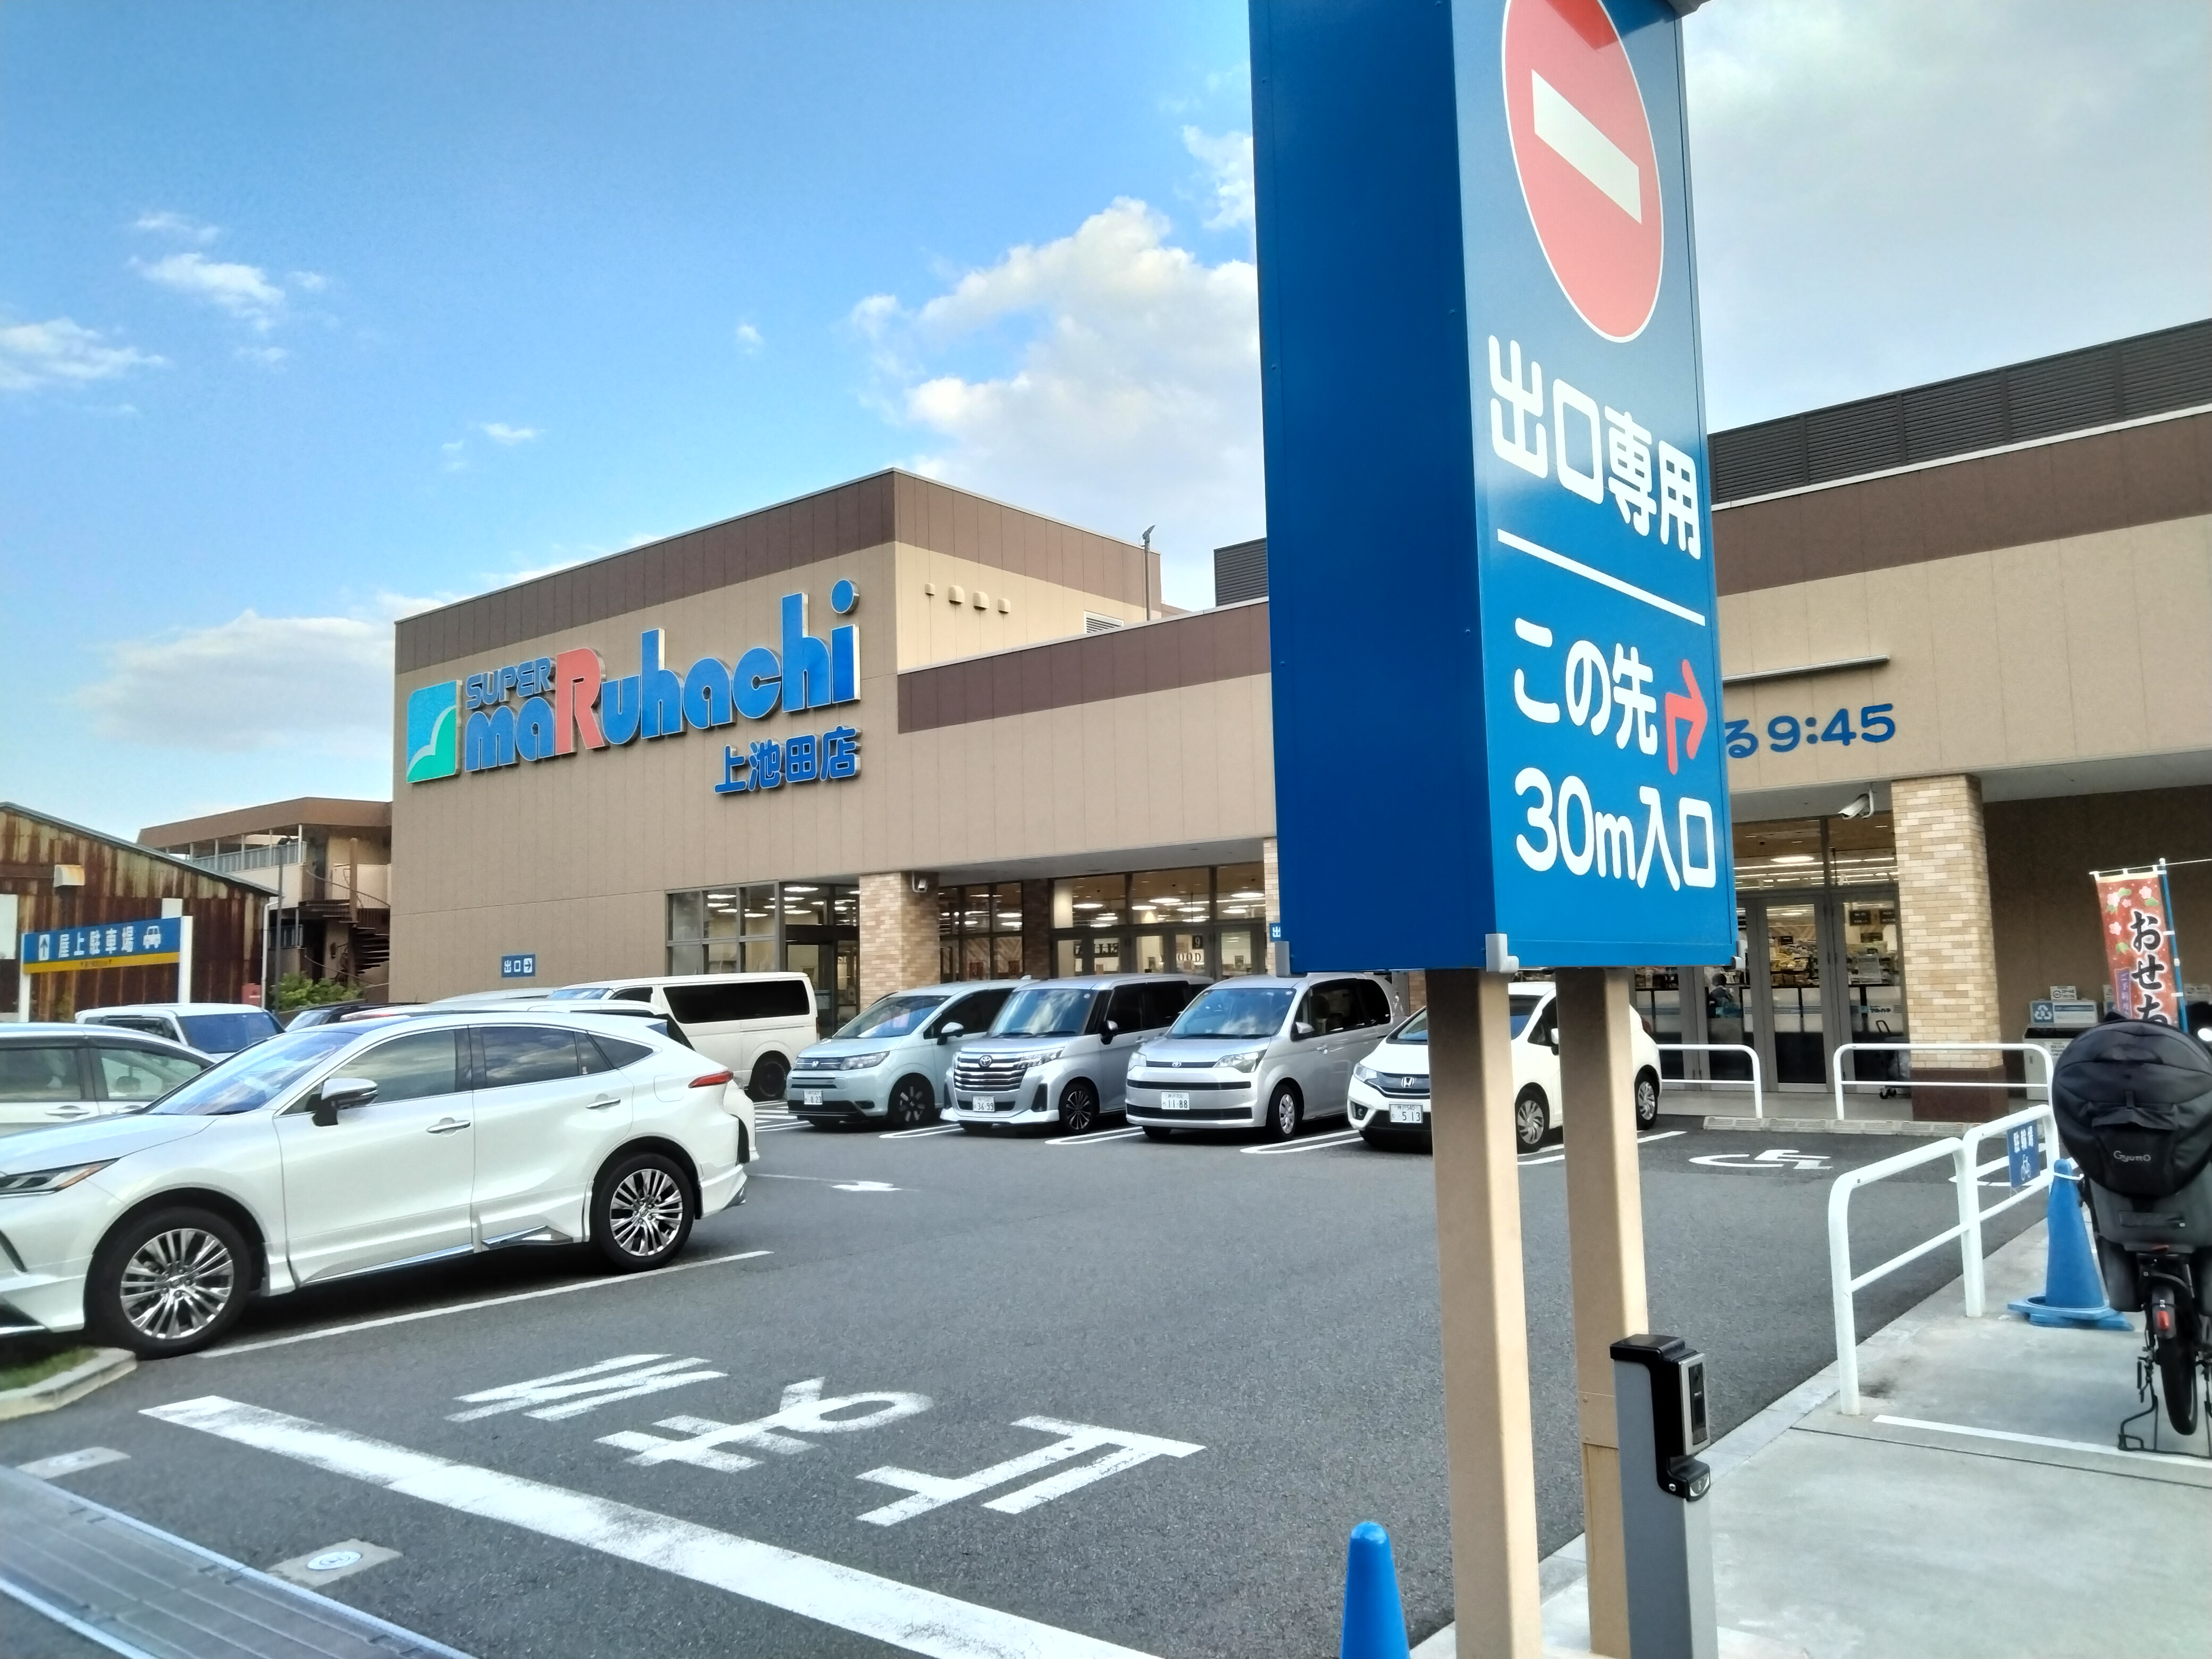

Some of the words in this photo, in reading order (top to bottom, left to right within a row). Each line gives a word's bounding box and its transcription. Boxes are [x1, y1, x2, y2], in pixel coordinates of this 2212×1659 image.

[1488, 334, 1702, 560] 出口専用
[466, 656, 556, 710] SUPER
[1514, 617, 1658, 756] この先
[714, 725, 862, 794] 上池田店
[1514, 767, 1716, 891] 30m入口
[58, 925, 134, 958] 屋上駐車場
[504, 960, 521, 973] 出口
